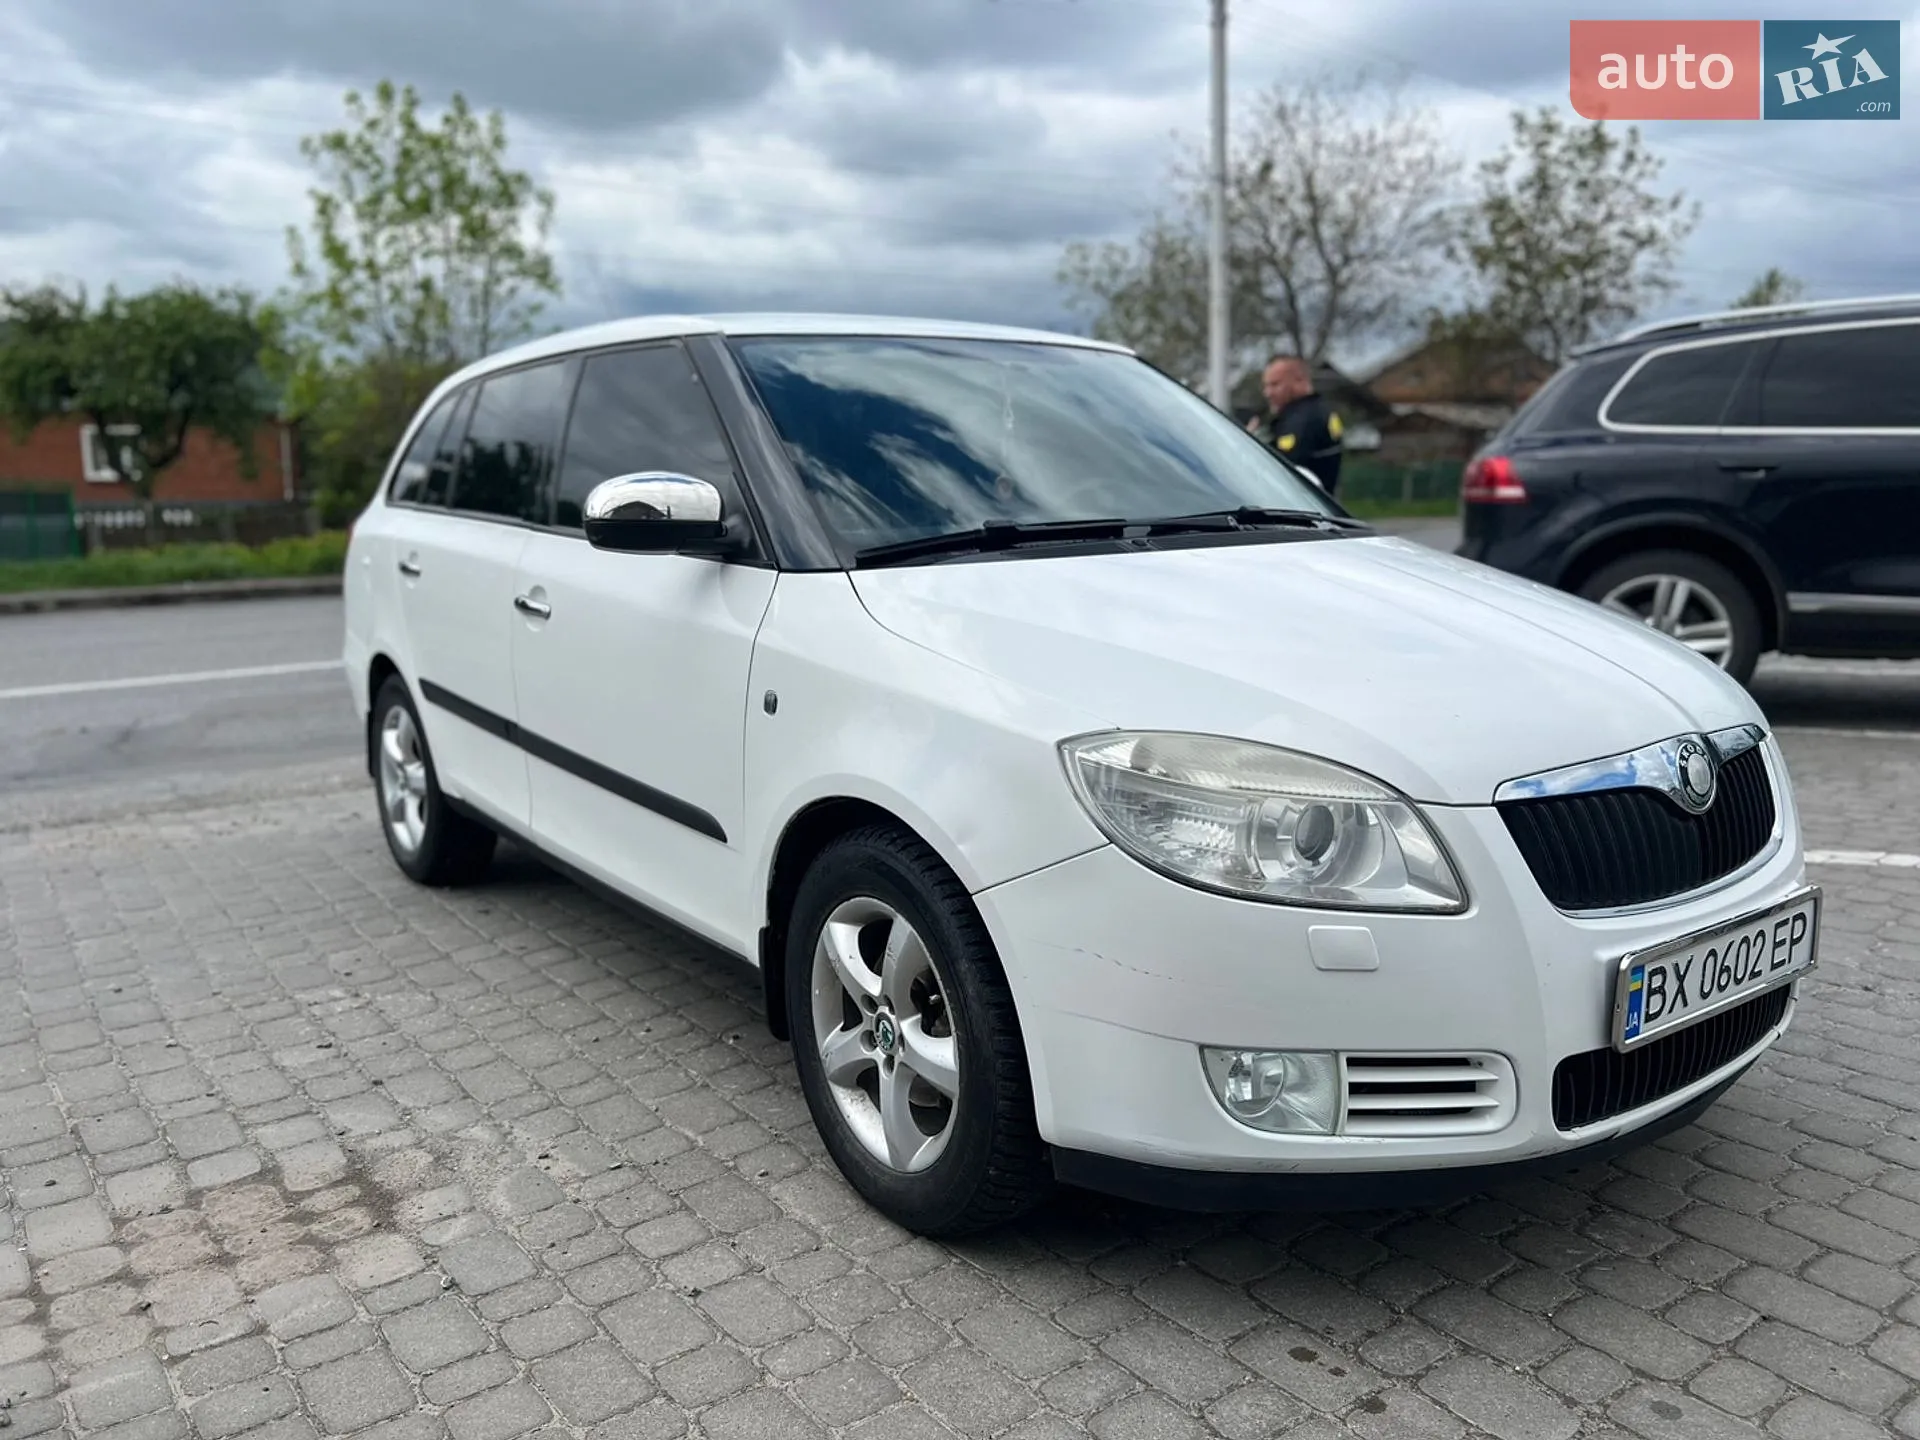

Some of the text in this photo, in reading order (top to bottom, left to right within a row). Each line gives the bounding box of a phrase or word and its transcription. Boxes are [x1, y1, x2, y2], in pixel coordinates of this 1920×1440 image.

[1645, 911, 1807, 1023] BX 0602 EP
